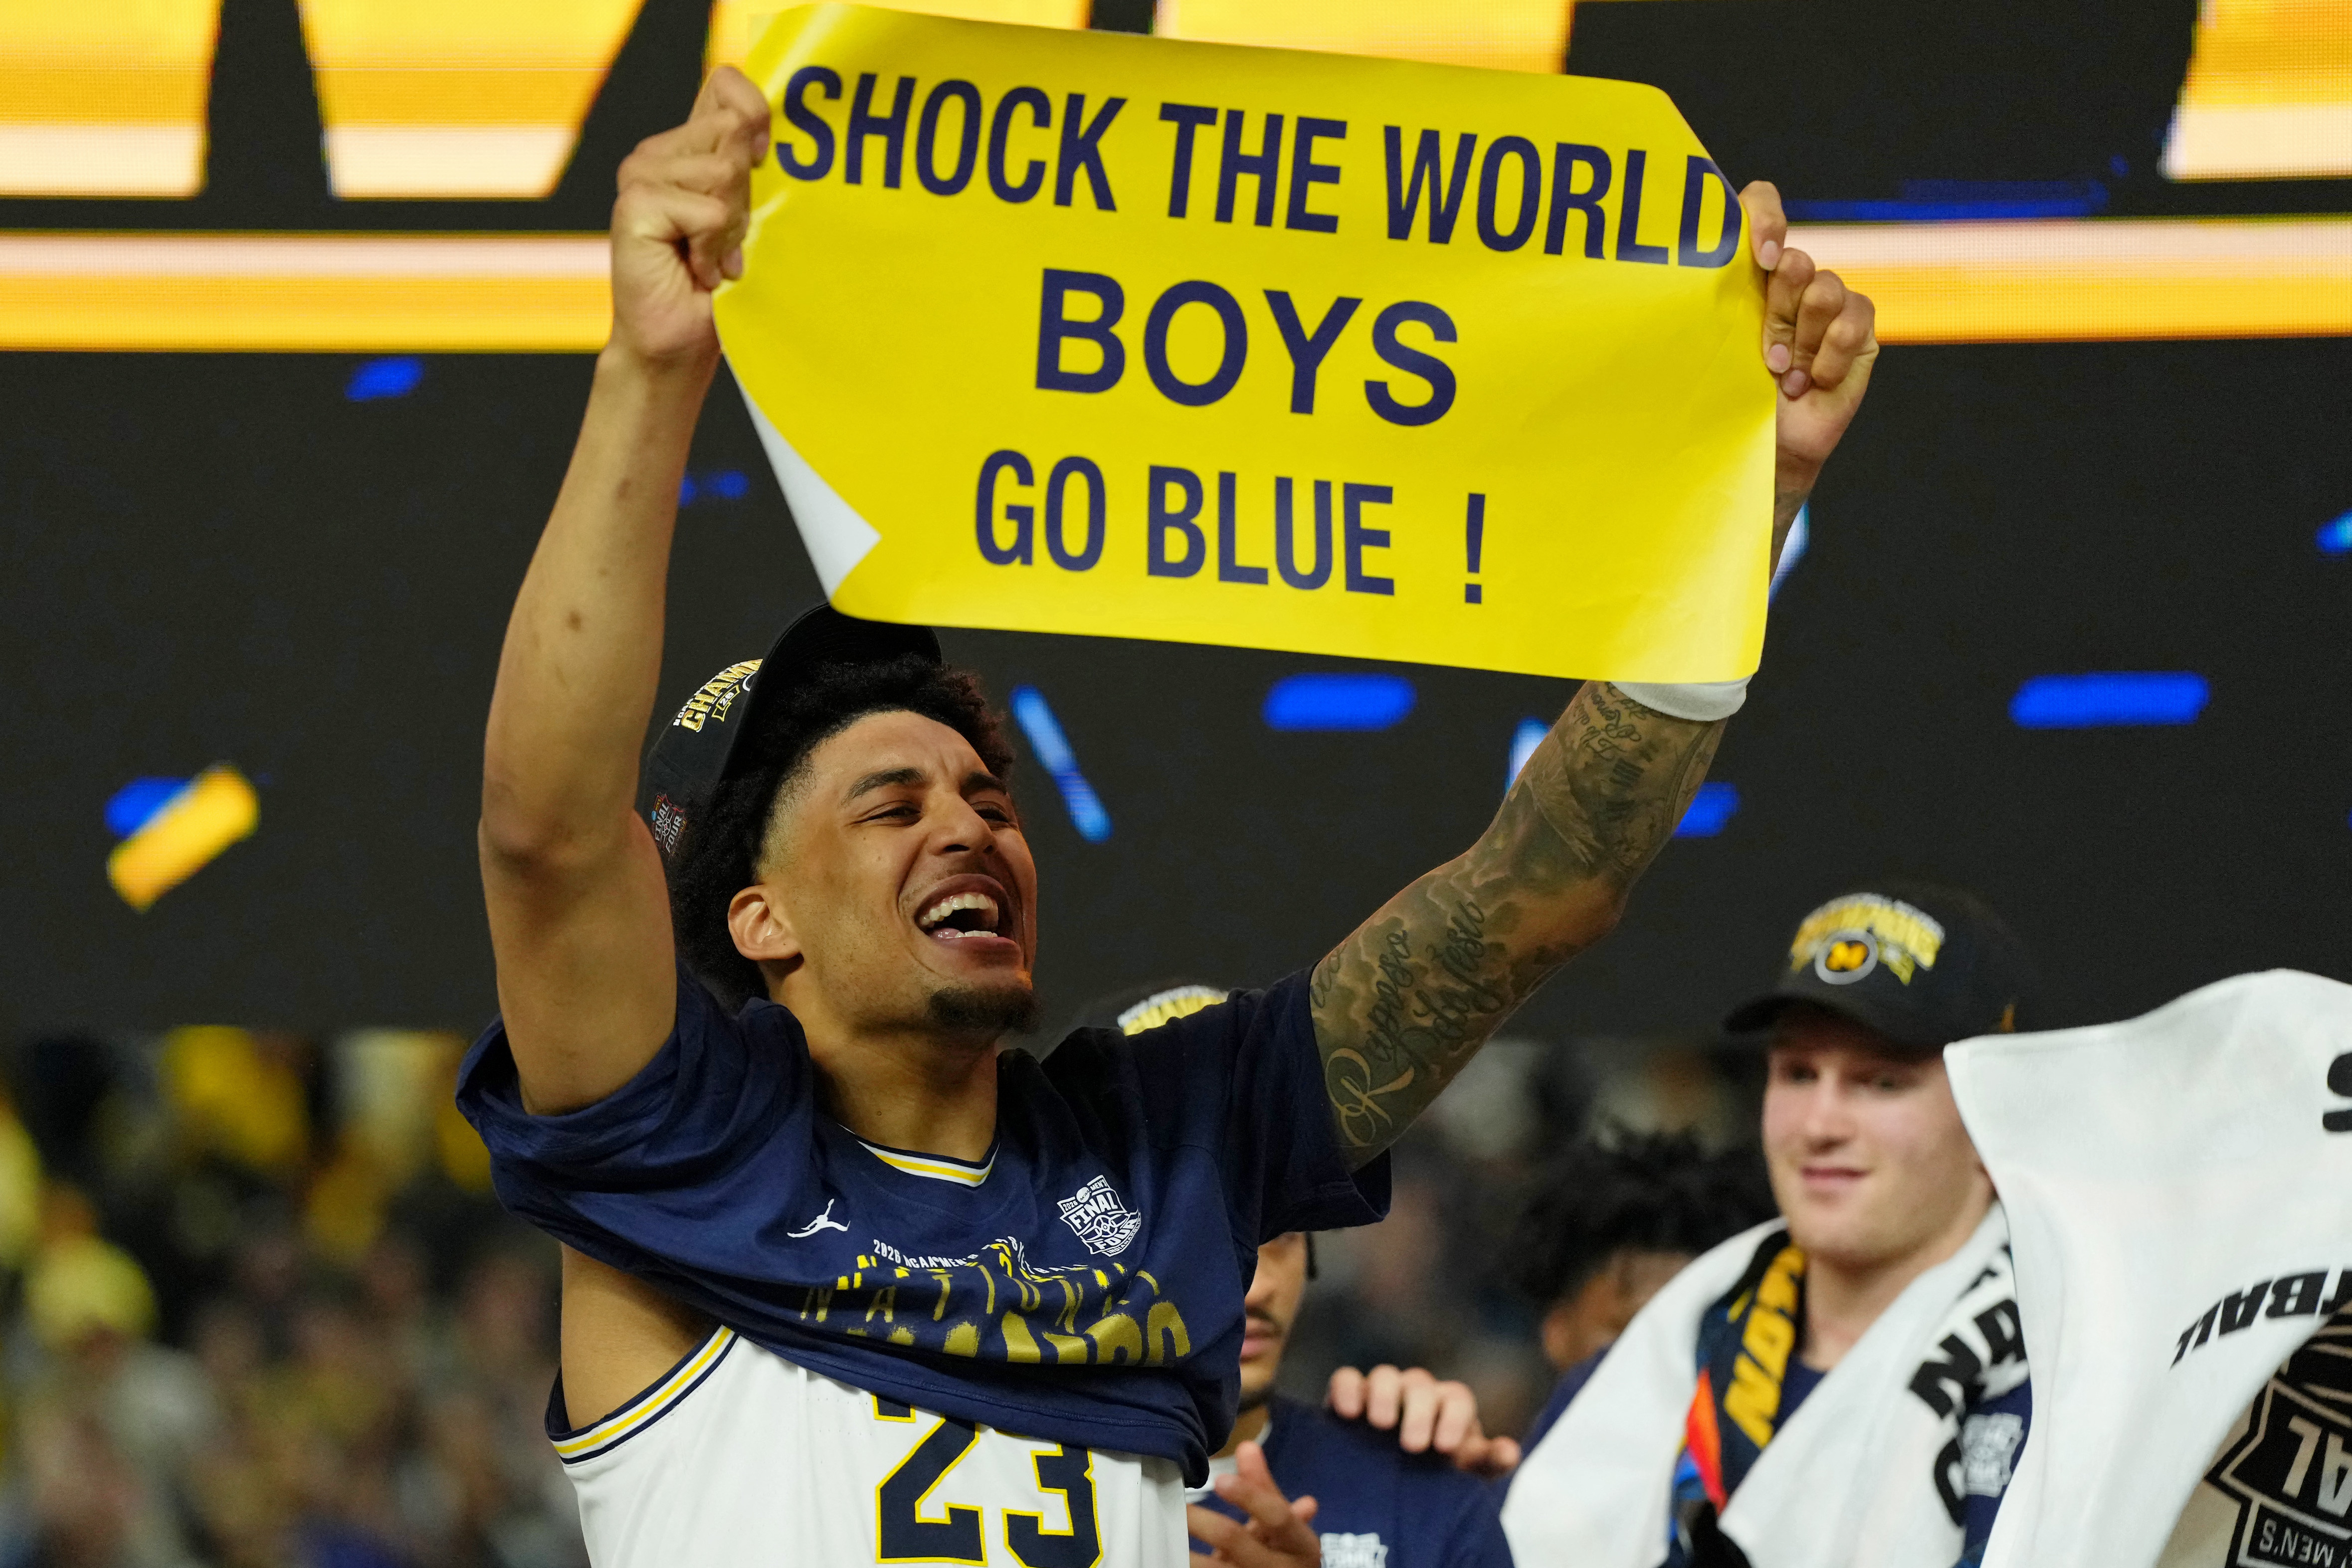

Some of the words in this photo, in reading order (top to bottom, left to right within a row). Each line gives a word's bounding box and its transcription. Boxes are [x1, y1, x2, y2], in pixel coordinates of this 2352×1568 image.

[776, 65, 1128, 212] SHOCK
[1159, 102, 1348, 233] THE
[1383, 125, 1742, 269] WORLD
[1035, 268, 1457, 427] BOYS
[976, 449, 1106, 572] GO
[1148, 465, 1394, 596] BLUE
[655, 802, 669, 841] FINAL
[665, 815, 682, 853] FOUR
[1063, 1200, 1078, 1211] 2026
[1090, 1179, 1107, 1191] MEN'S
[1068, 1192, 1118, 1230] FINAL
[873, 1239, 901, 1264] 2026
[1094, 1217, 1138, 1250] FOUR
[872, 1389, 1104, 1568] 23
[2259, 1518, 2334, 1568] MEN'S
